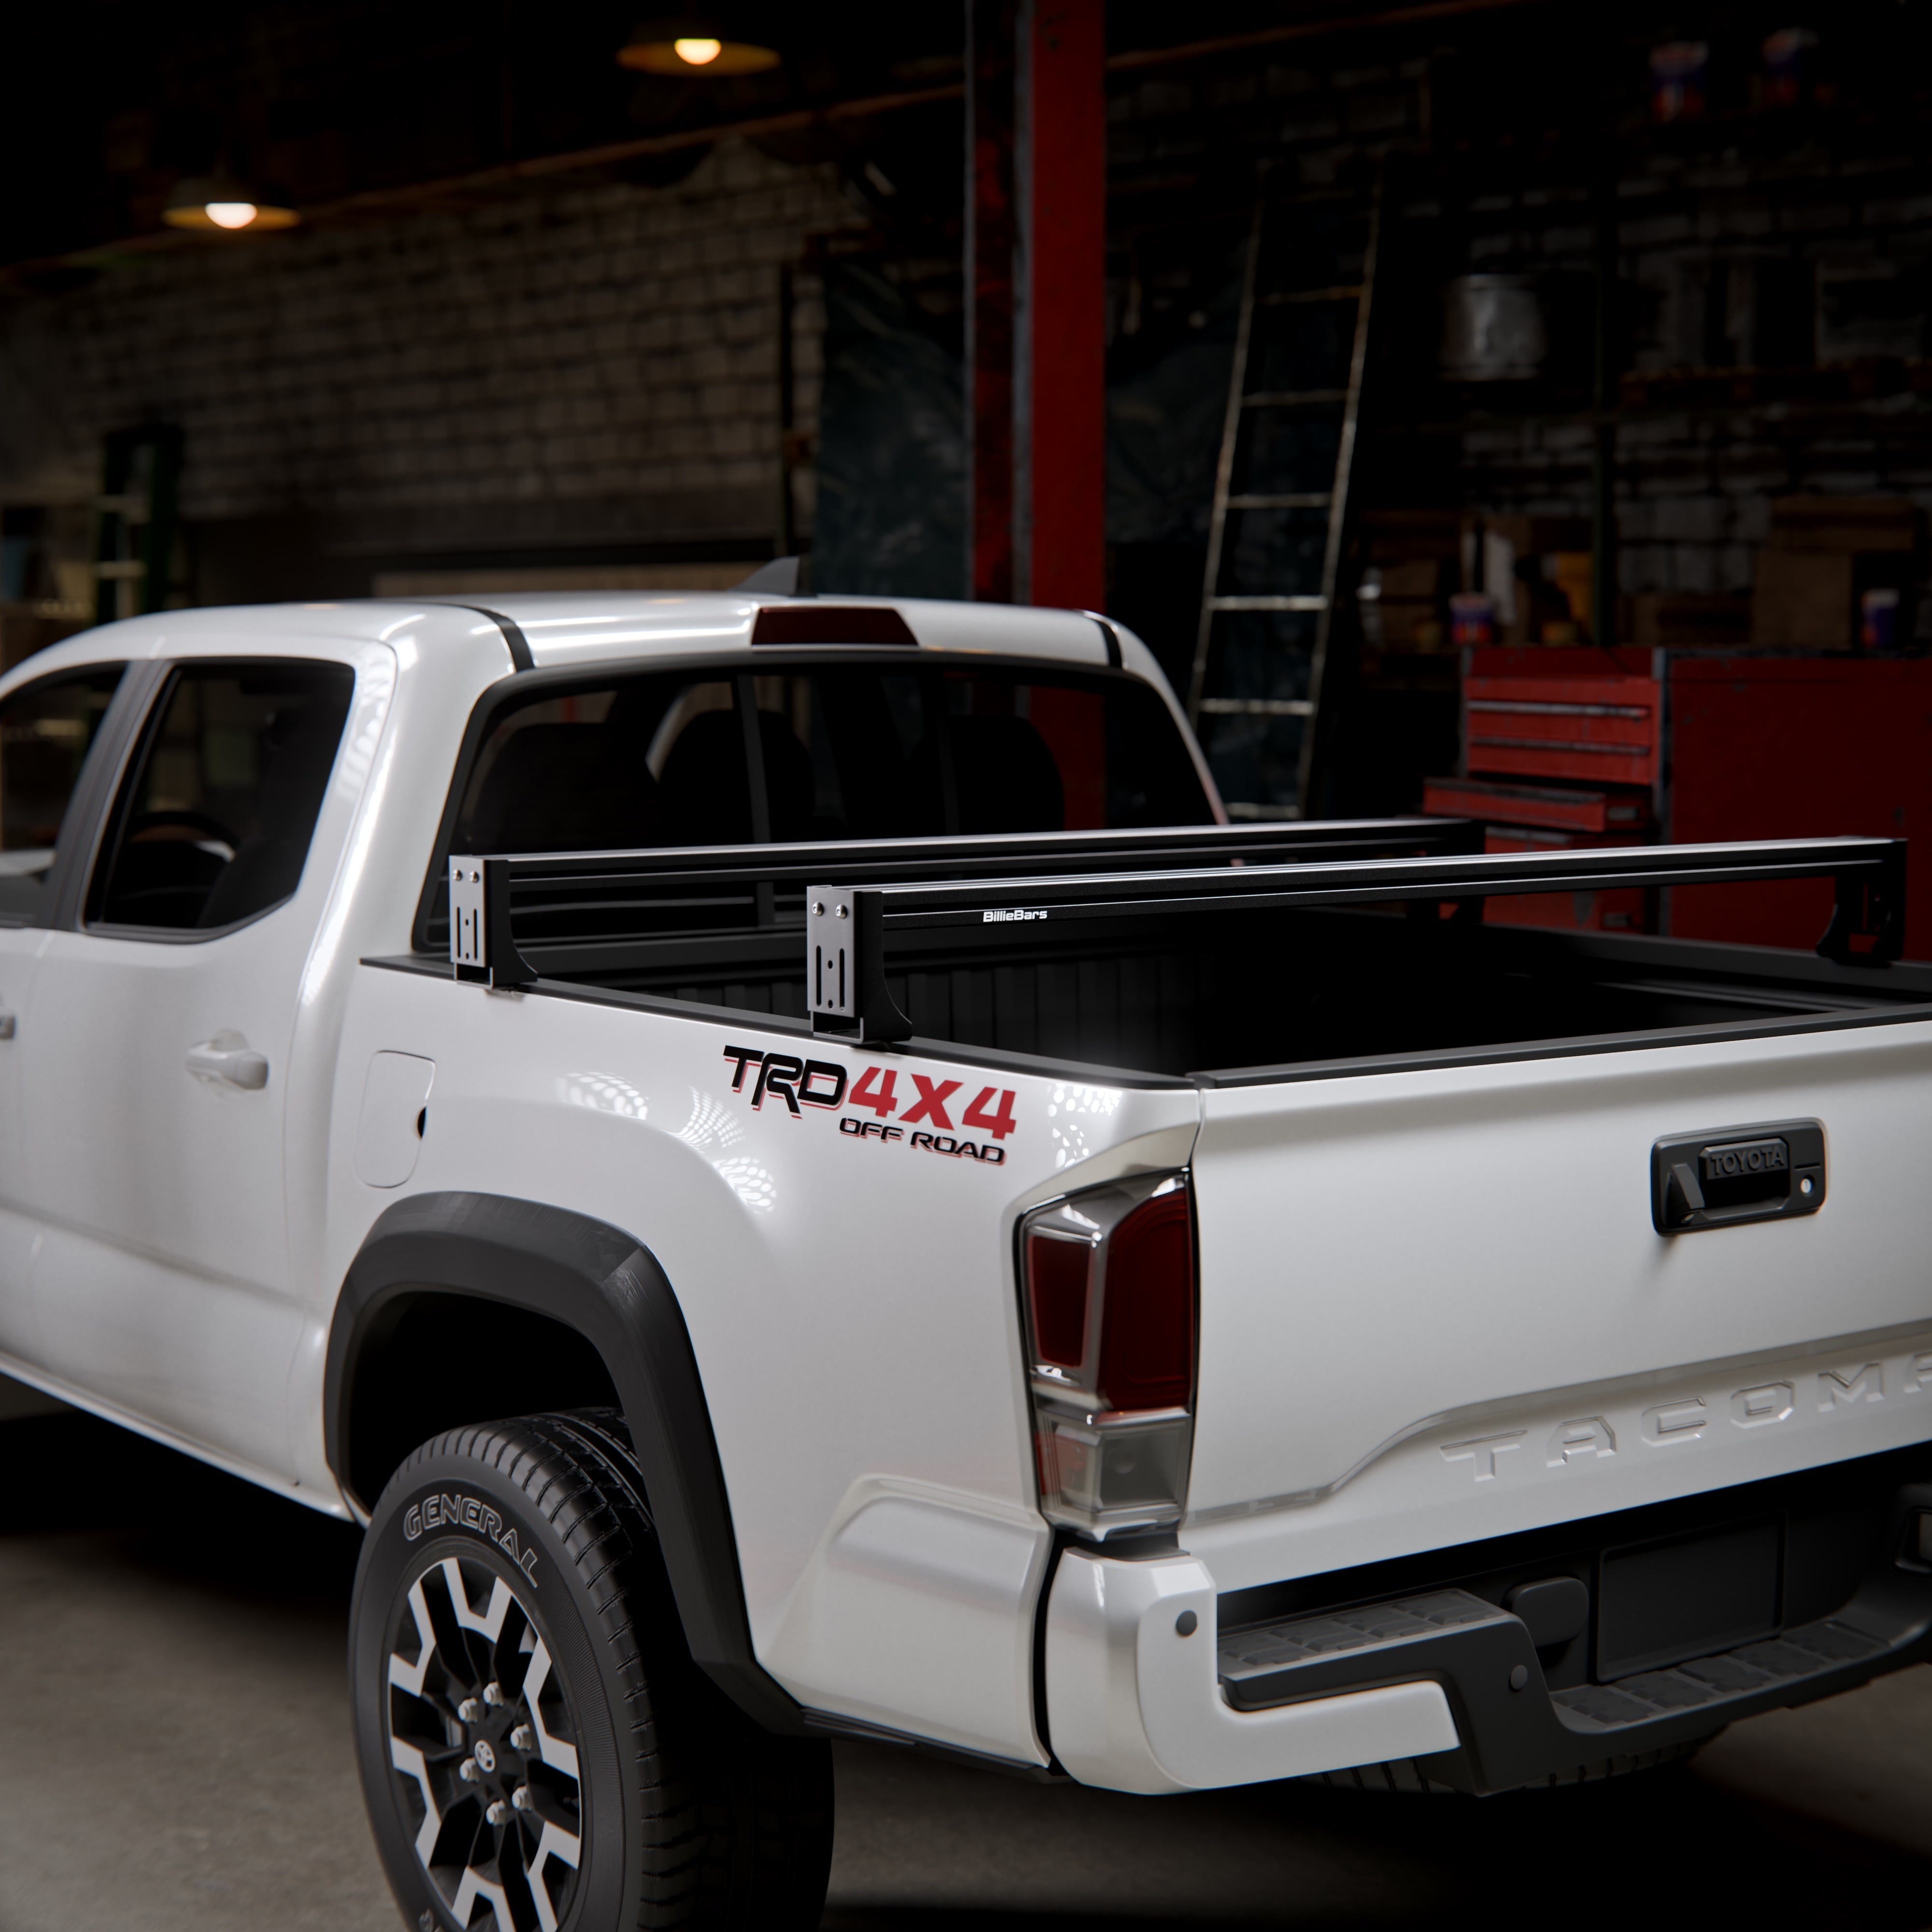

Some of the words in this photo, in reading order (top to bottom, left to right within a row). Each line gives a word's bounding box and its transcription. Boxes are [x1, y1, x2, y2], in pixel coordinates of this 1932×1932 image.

[983, 909, 1048, 923] BillieBars
[839, 1117, 905, 1143] OFF
[909, 1131, 1006, 1166] ROAD
[1711, 1146, 1785, 1175] TOYOTA
[404, 1493, 538, 1588] GENERAL
